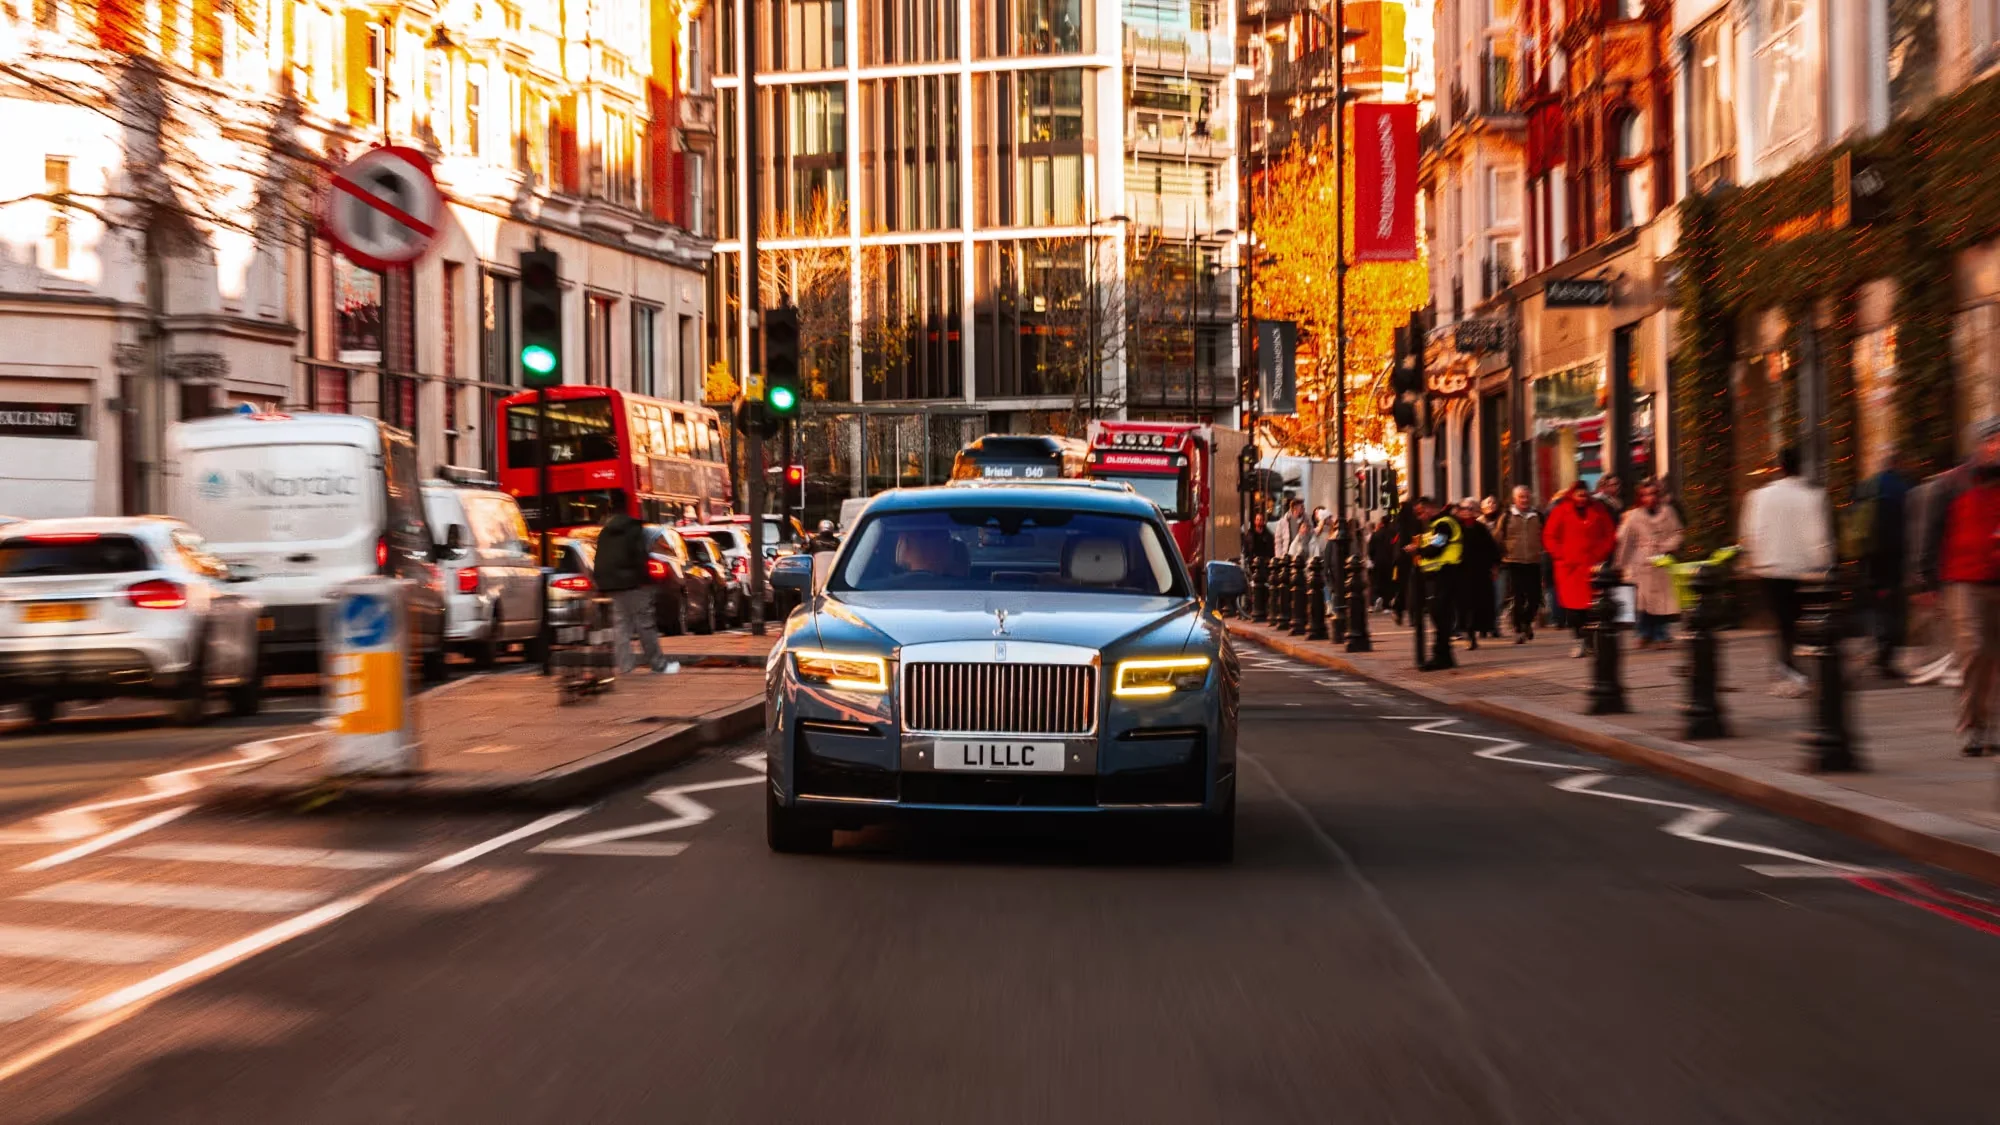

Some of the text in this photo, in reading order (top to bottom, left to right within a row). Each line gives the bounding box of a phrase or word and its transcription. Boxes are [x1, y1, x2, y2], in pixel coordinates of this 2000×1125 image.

[551, 445, 574, 461] 74
[984, 466, 1043, 478] Bristol 040
